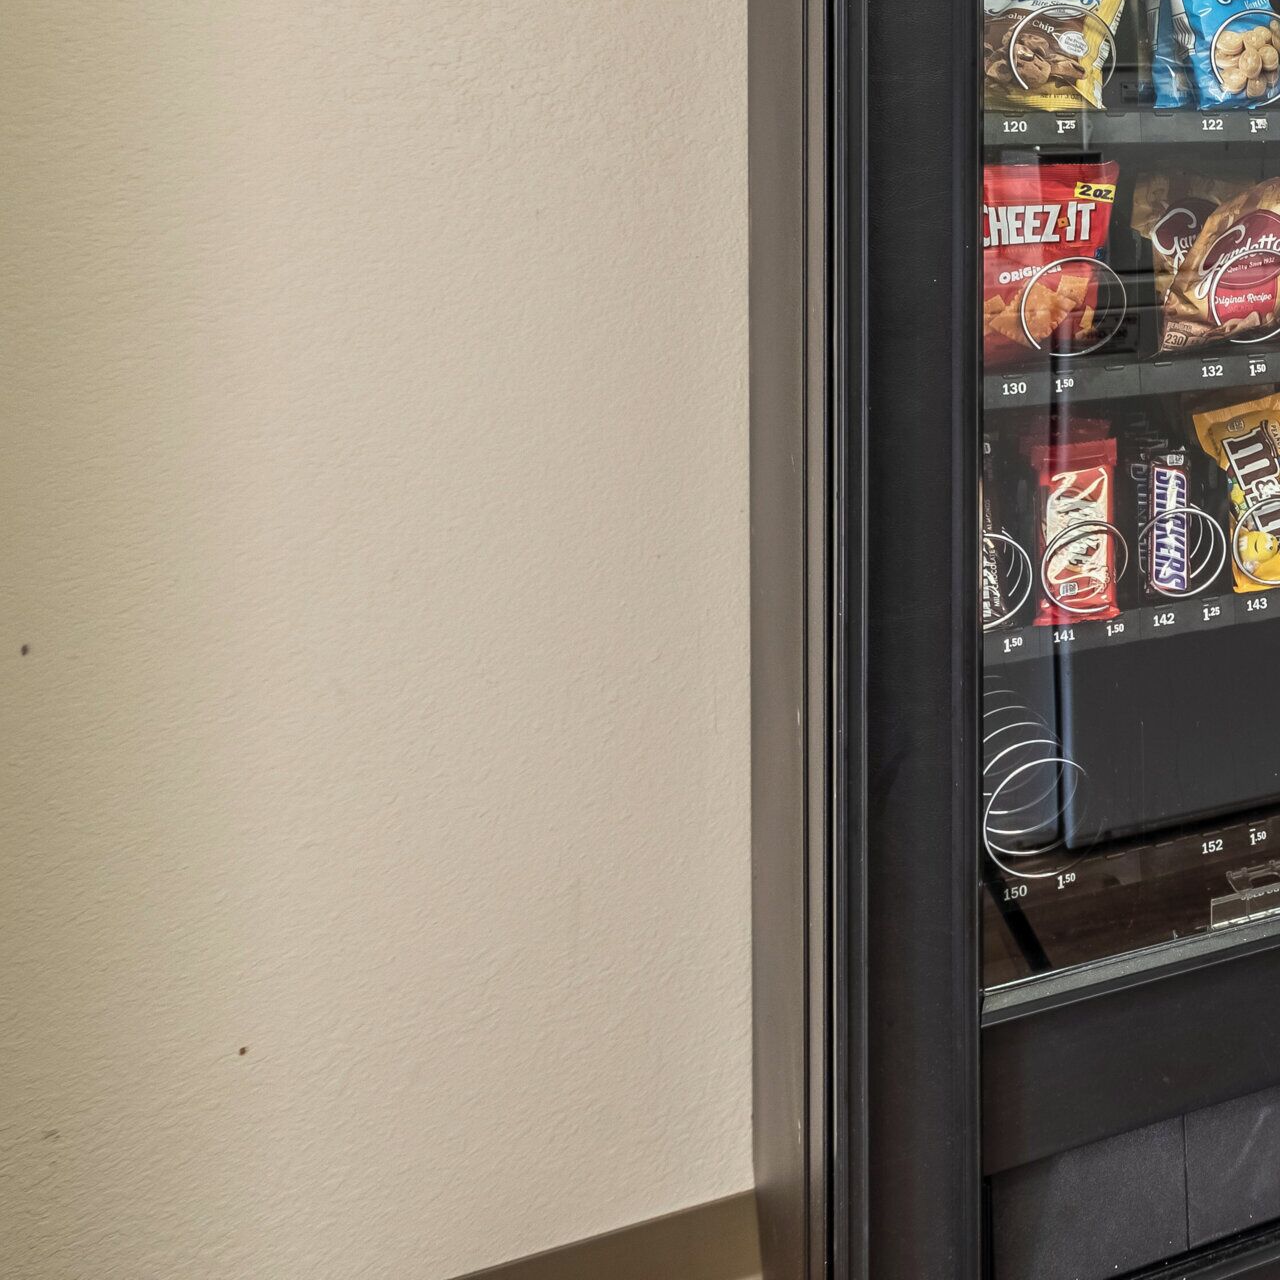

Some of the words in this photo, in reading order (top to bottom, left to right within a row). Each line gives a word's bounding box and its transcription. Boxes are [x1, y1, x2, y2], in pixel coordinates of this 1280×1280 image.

[1032, 20, 1055, 33] Chip
[1004, 122, 1027, 132] 120
[1202, 120, 1224, 130] 122
[1080, 185, 1093, 197] 2
[1165, 333, 1185, 345] 230
[1202, 366, 1223, 378] 132
[1002, 382, 1026, 395] 130
[1246, 599, 1268, 610] 143
[1153, 614, 1174, 625] 142
[1054, 630, 1075, 642] 141
[1202, 840, 1223, 854] 152
[1004, 886, 1028, 901] 150
